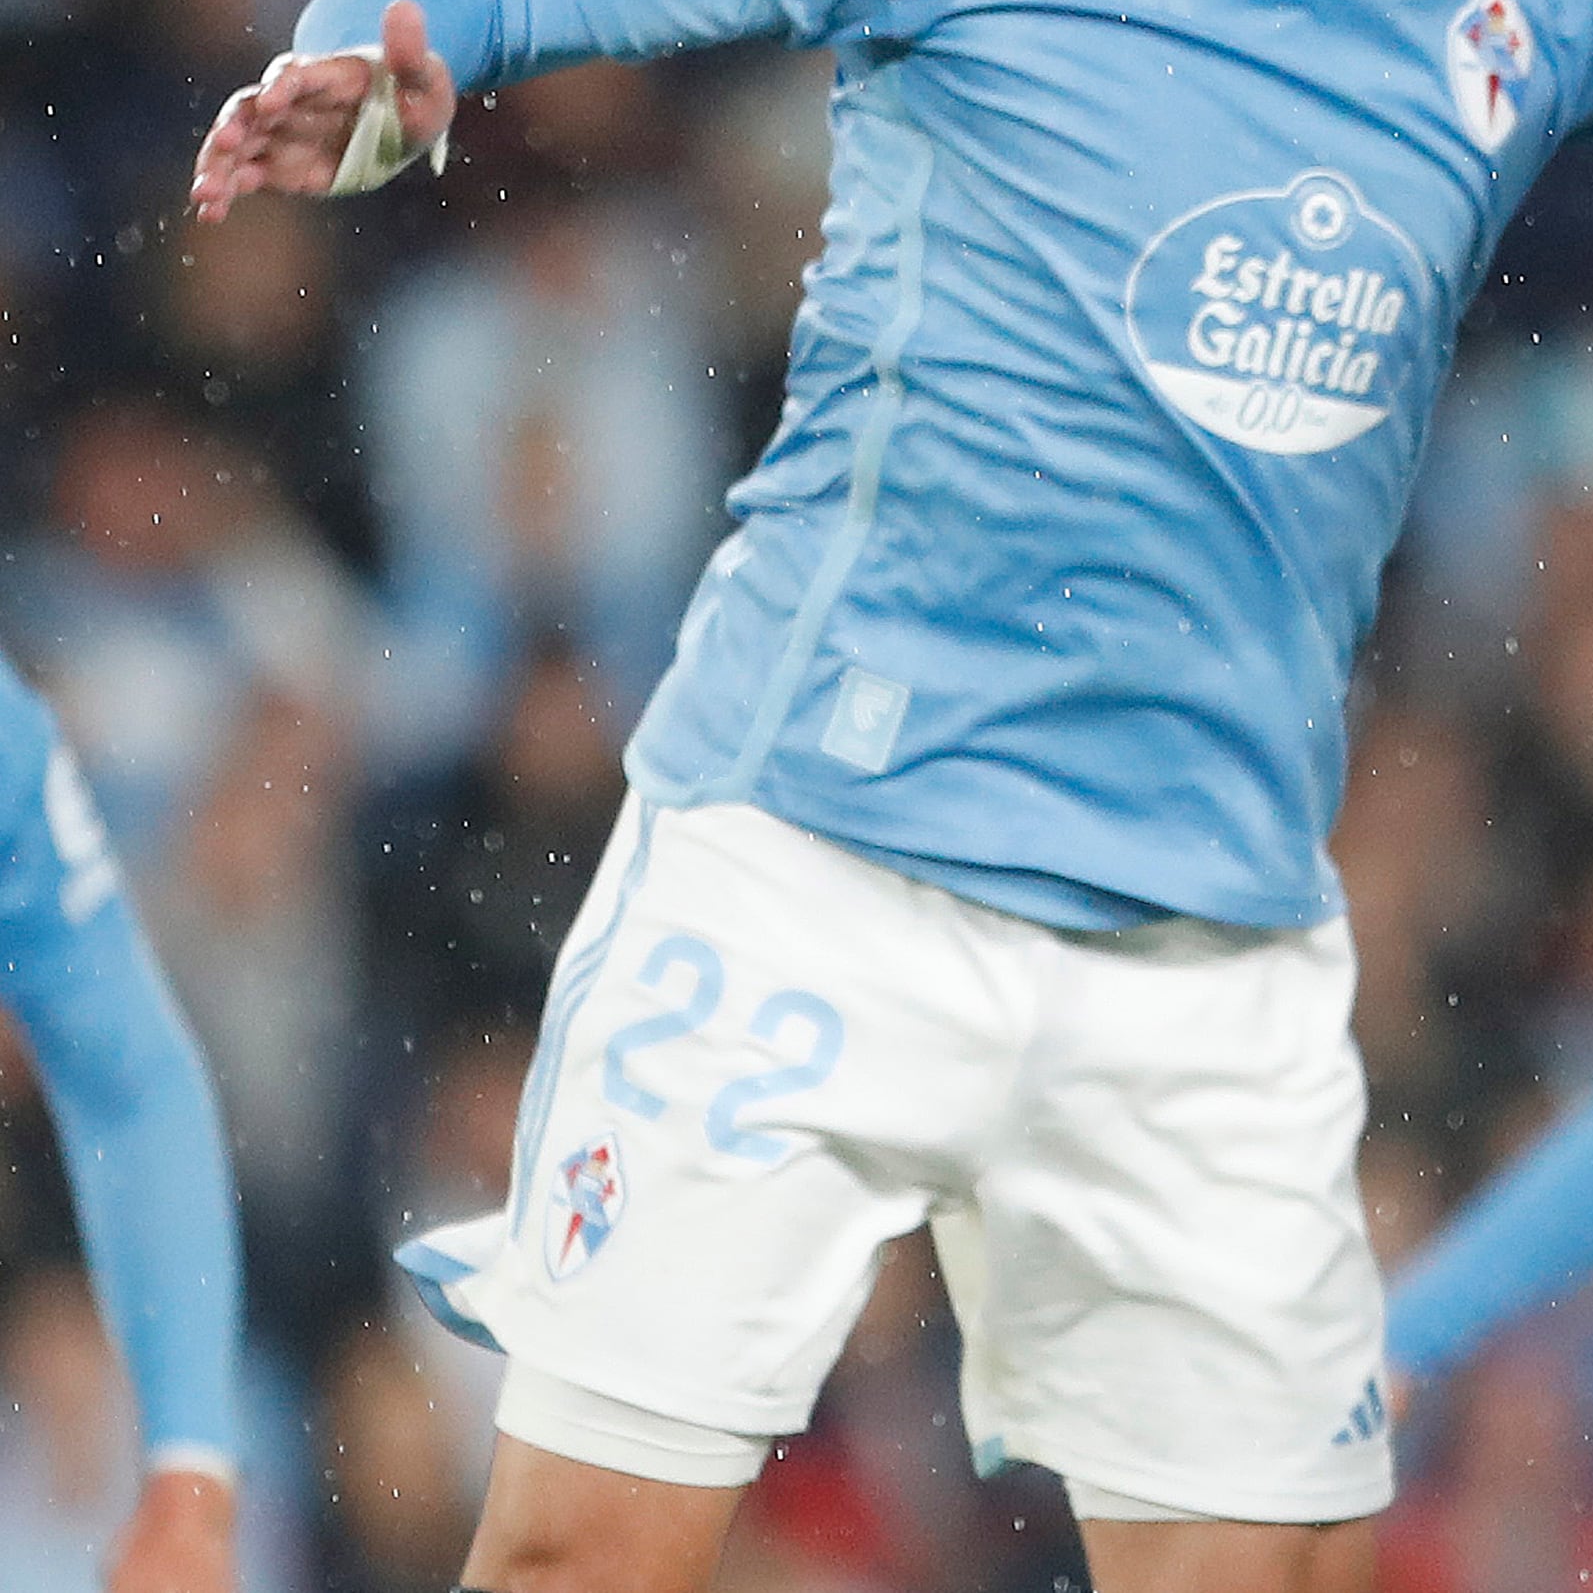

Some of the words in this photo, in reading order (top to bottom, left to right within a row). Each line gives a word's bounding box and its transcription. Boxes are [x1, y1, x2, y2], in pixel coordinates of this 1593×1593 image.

[1192, 234, 1404, 334] Estrella
[1189, 302, 1379, 395] Galicia
[603, 935, 845, 1163] 22
